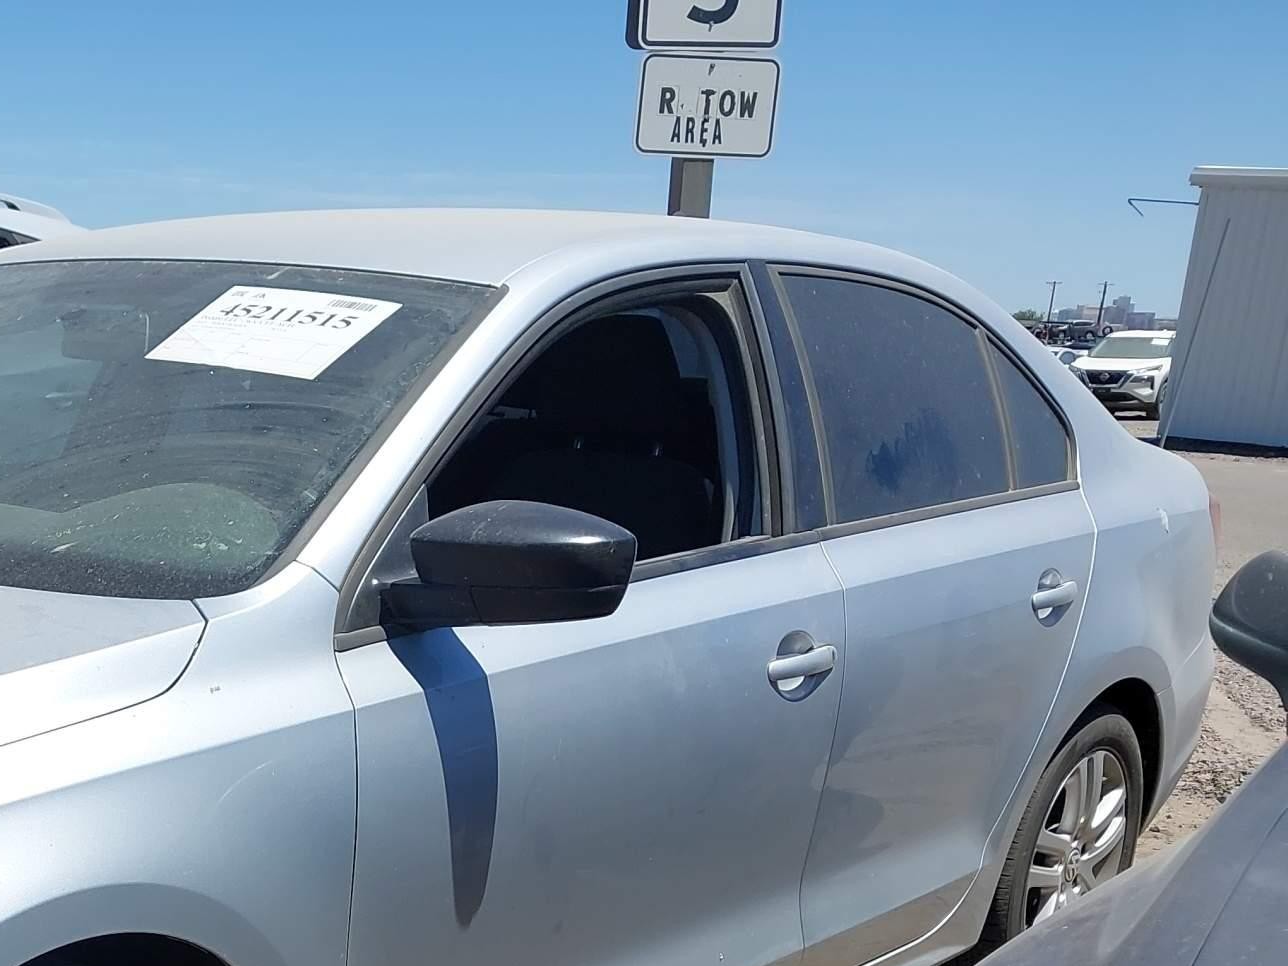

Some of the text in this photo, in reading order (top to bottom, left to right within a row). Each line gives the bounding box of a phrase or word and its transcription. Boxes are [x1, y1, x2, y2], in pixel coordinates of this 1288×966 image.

[700, 88, 759, 119] TOW
[669, 115, 723, 146] AREA
[219, 303, 361, 330] 45211515
